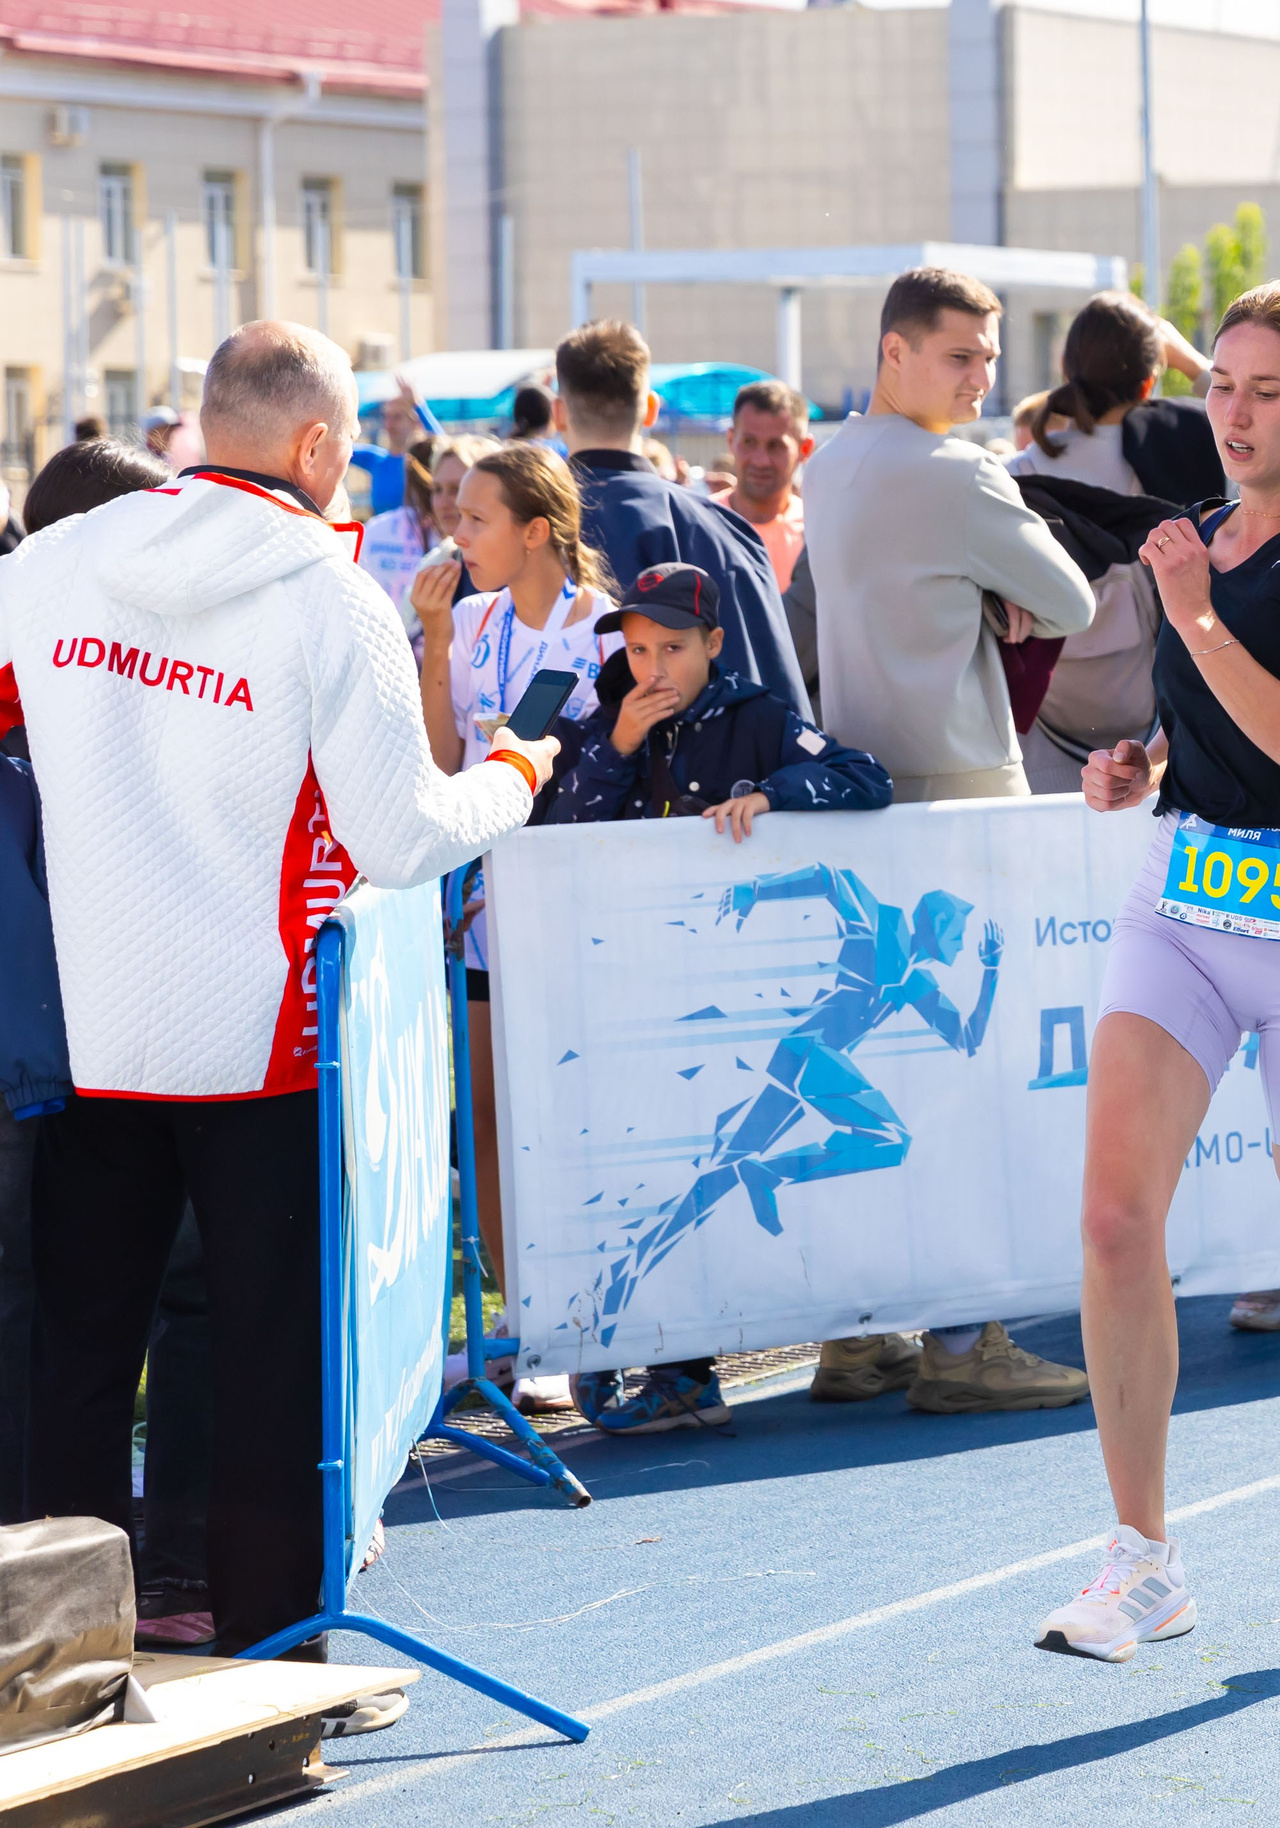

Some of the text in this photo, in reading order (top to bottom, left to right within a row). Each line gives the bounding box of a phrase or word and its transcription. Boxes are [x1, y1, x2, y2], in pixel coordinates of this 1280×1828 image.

[52, 637, 255, 713] UDMURTIA
[1227, 827, 1262, 841] МИЛЯ
[1034, 915, 1115, 948] Исто
